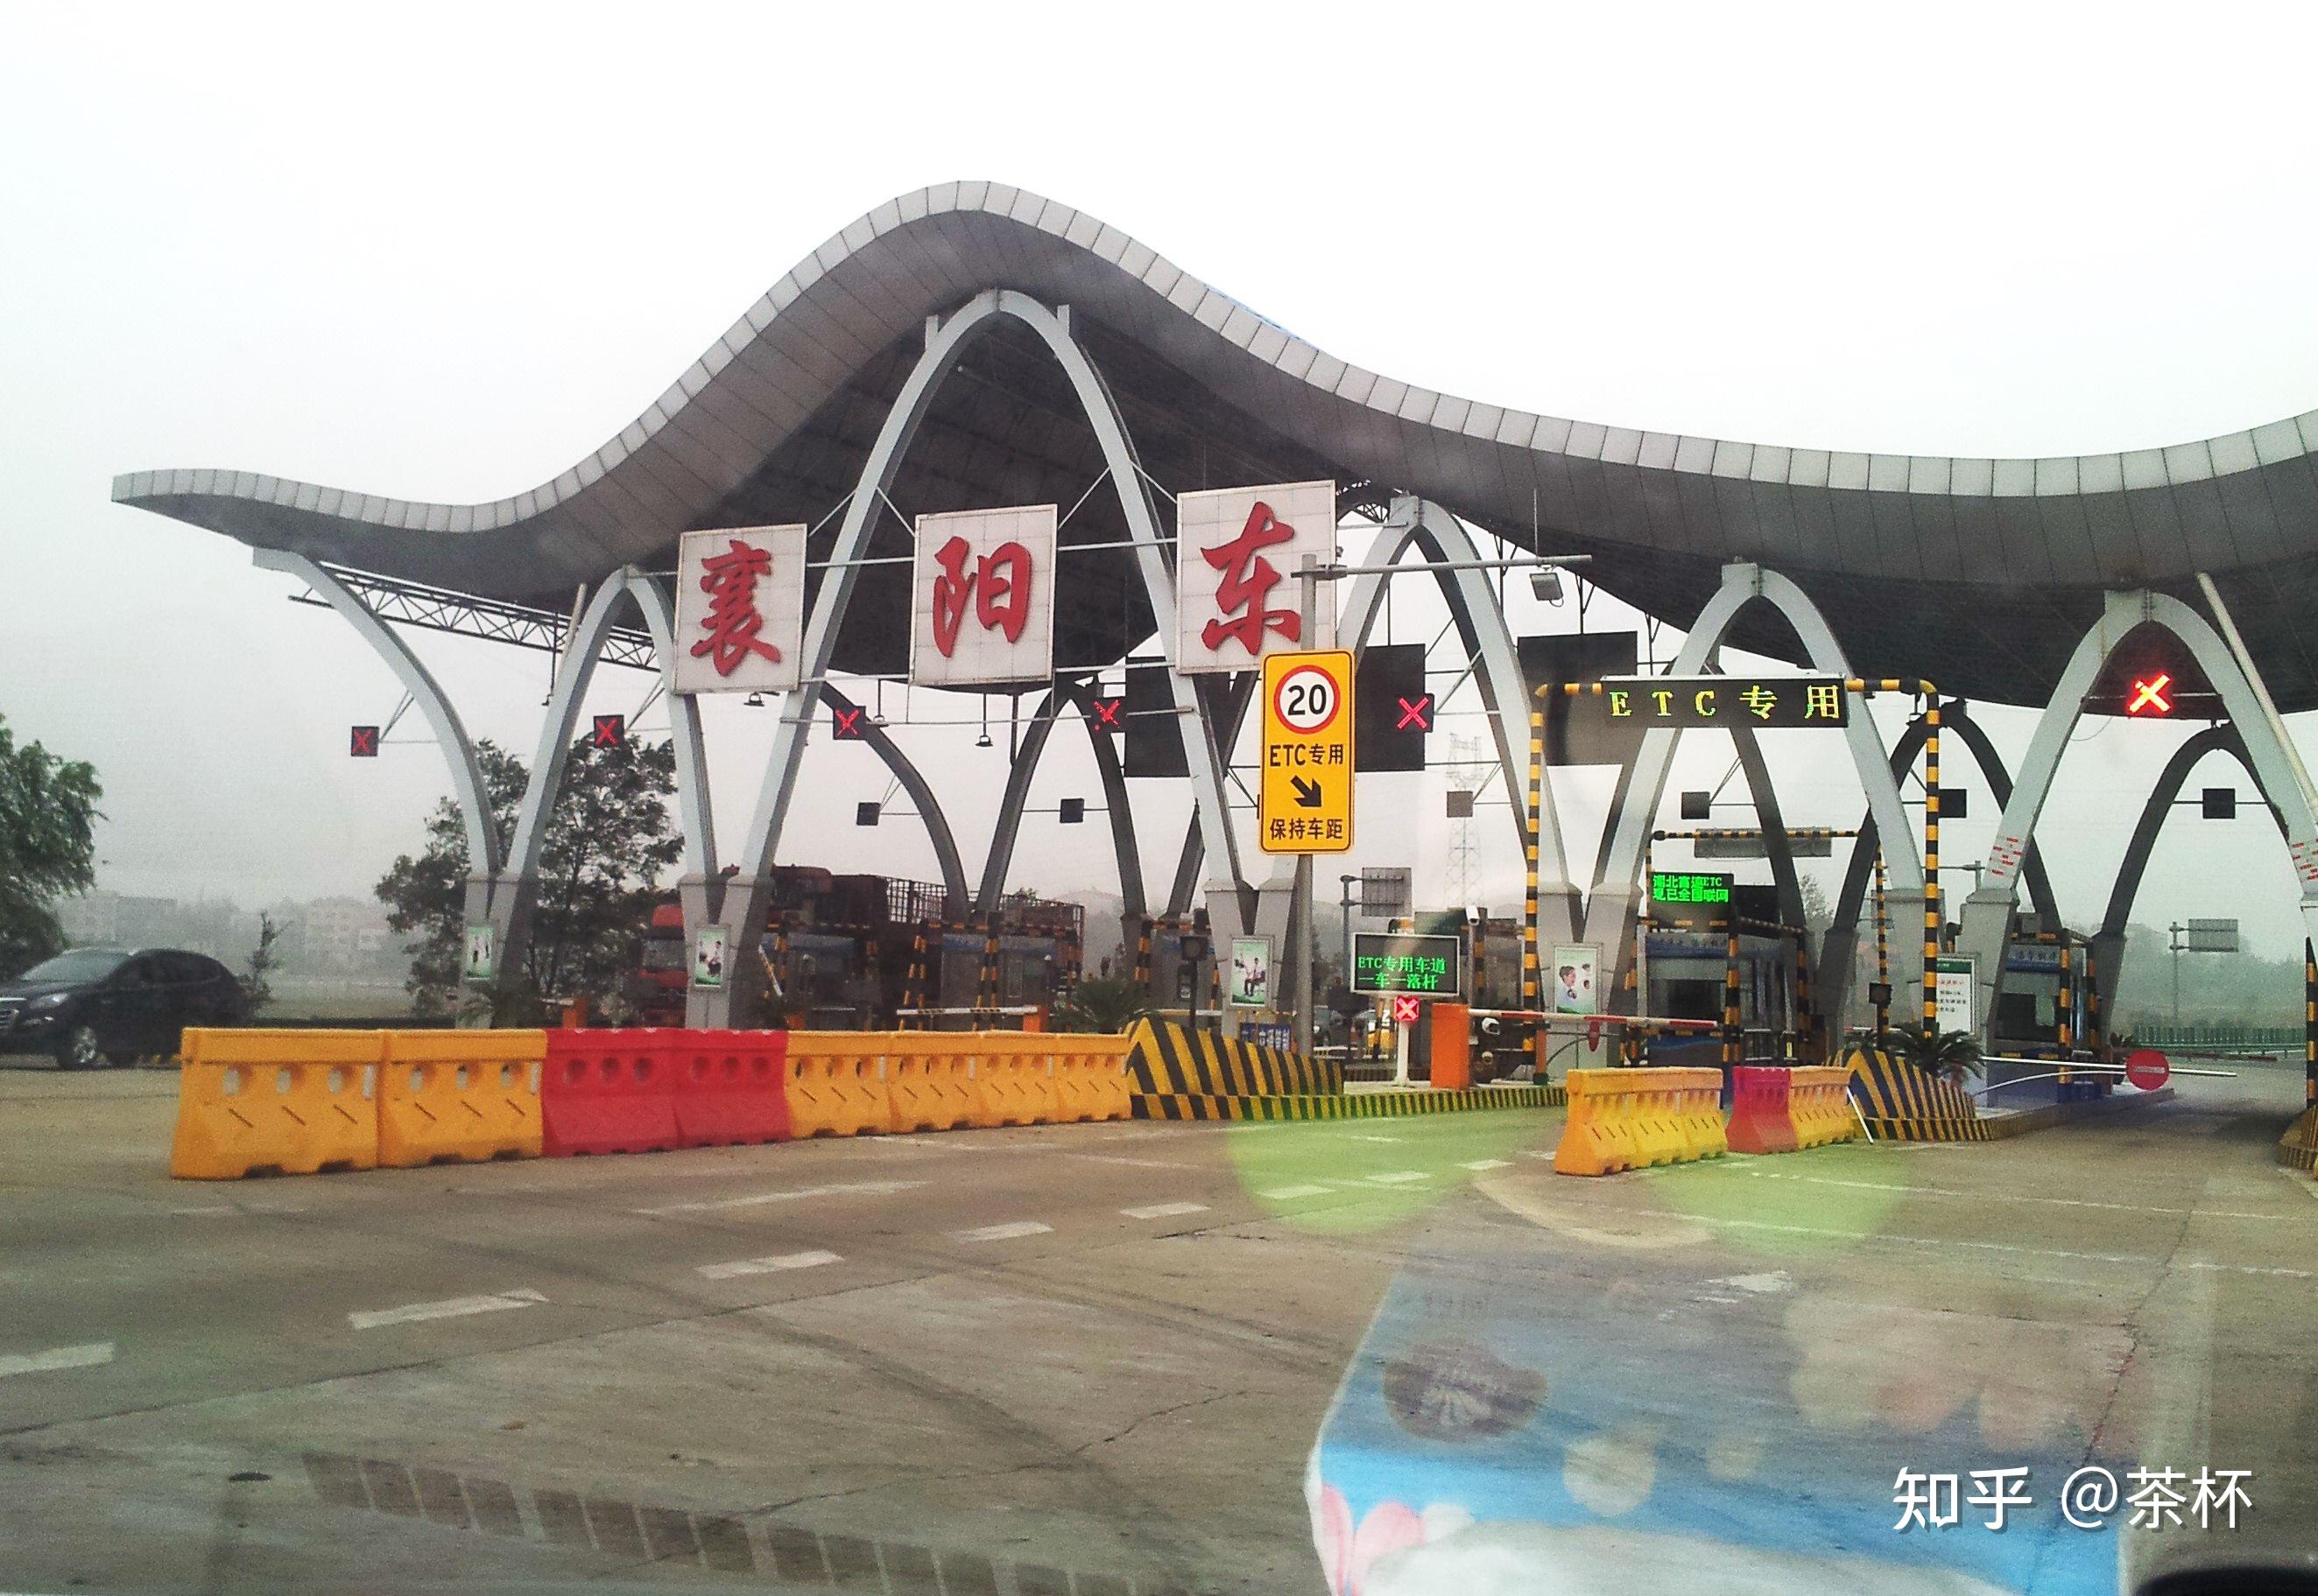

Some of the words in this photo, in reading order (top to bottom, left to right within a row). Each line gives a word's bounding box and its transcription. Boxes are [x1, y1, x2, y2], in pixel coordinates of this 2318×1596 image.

[690, 502, 1302, 677] 襄阳东
[1286, 684, 1328, 716] 20
[1610, 686, 1841, 719] ETC专用
[1270, 743, 1345, 767] ETC专用
[1269, 817, 1344, 840] 保持车距
[1358, 956, 1446, 974] ETC专用车道
